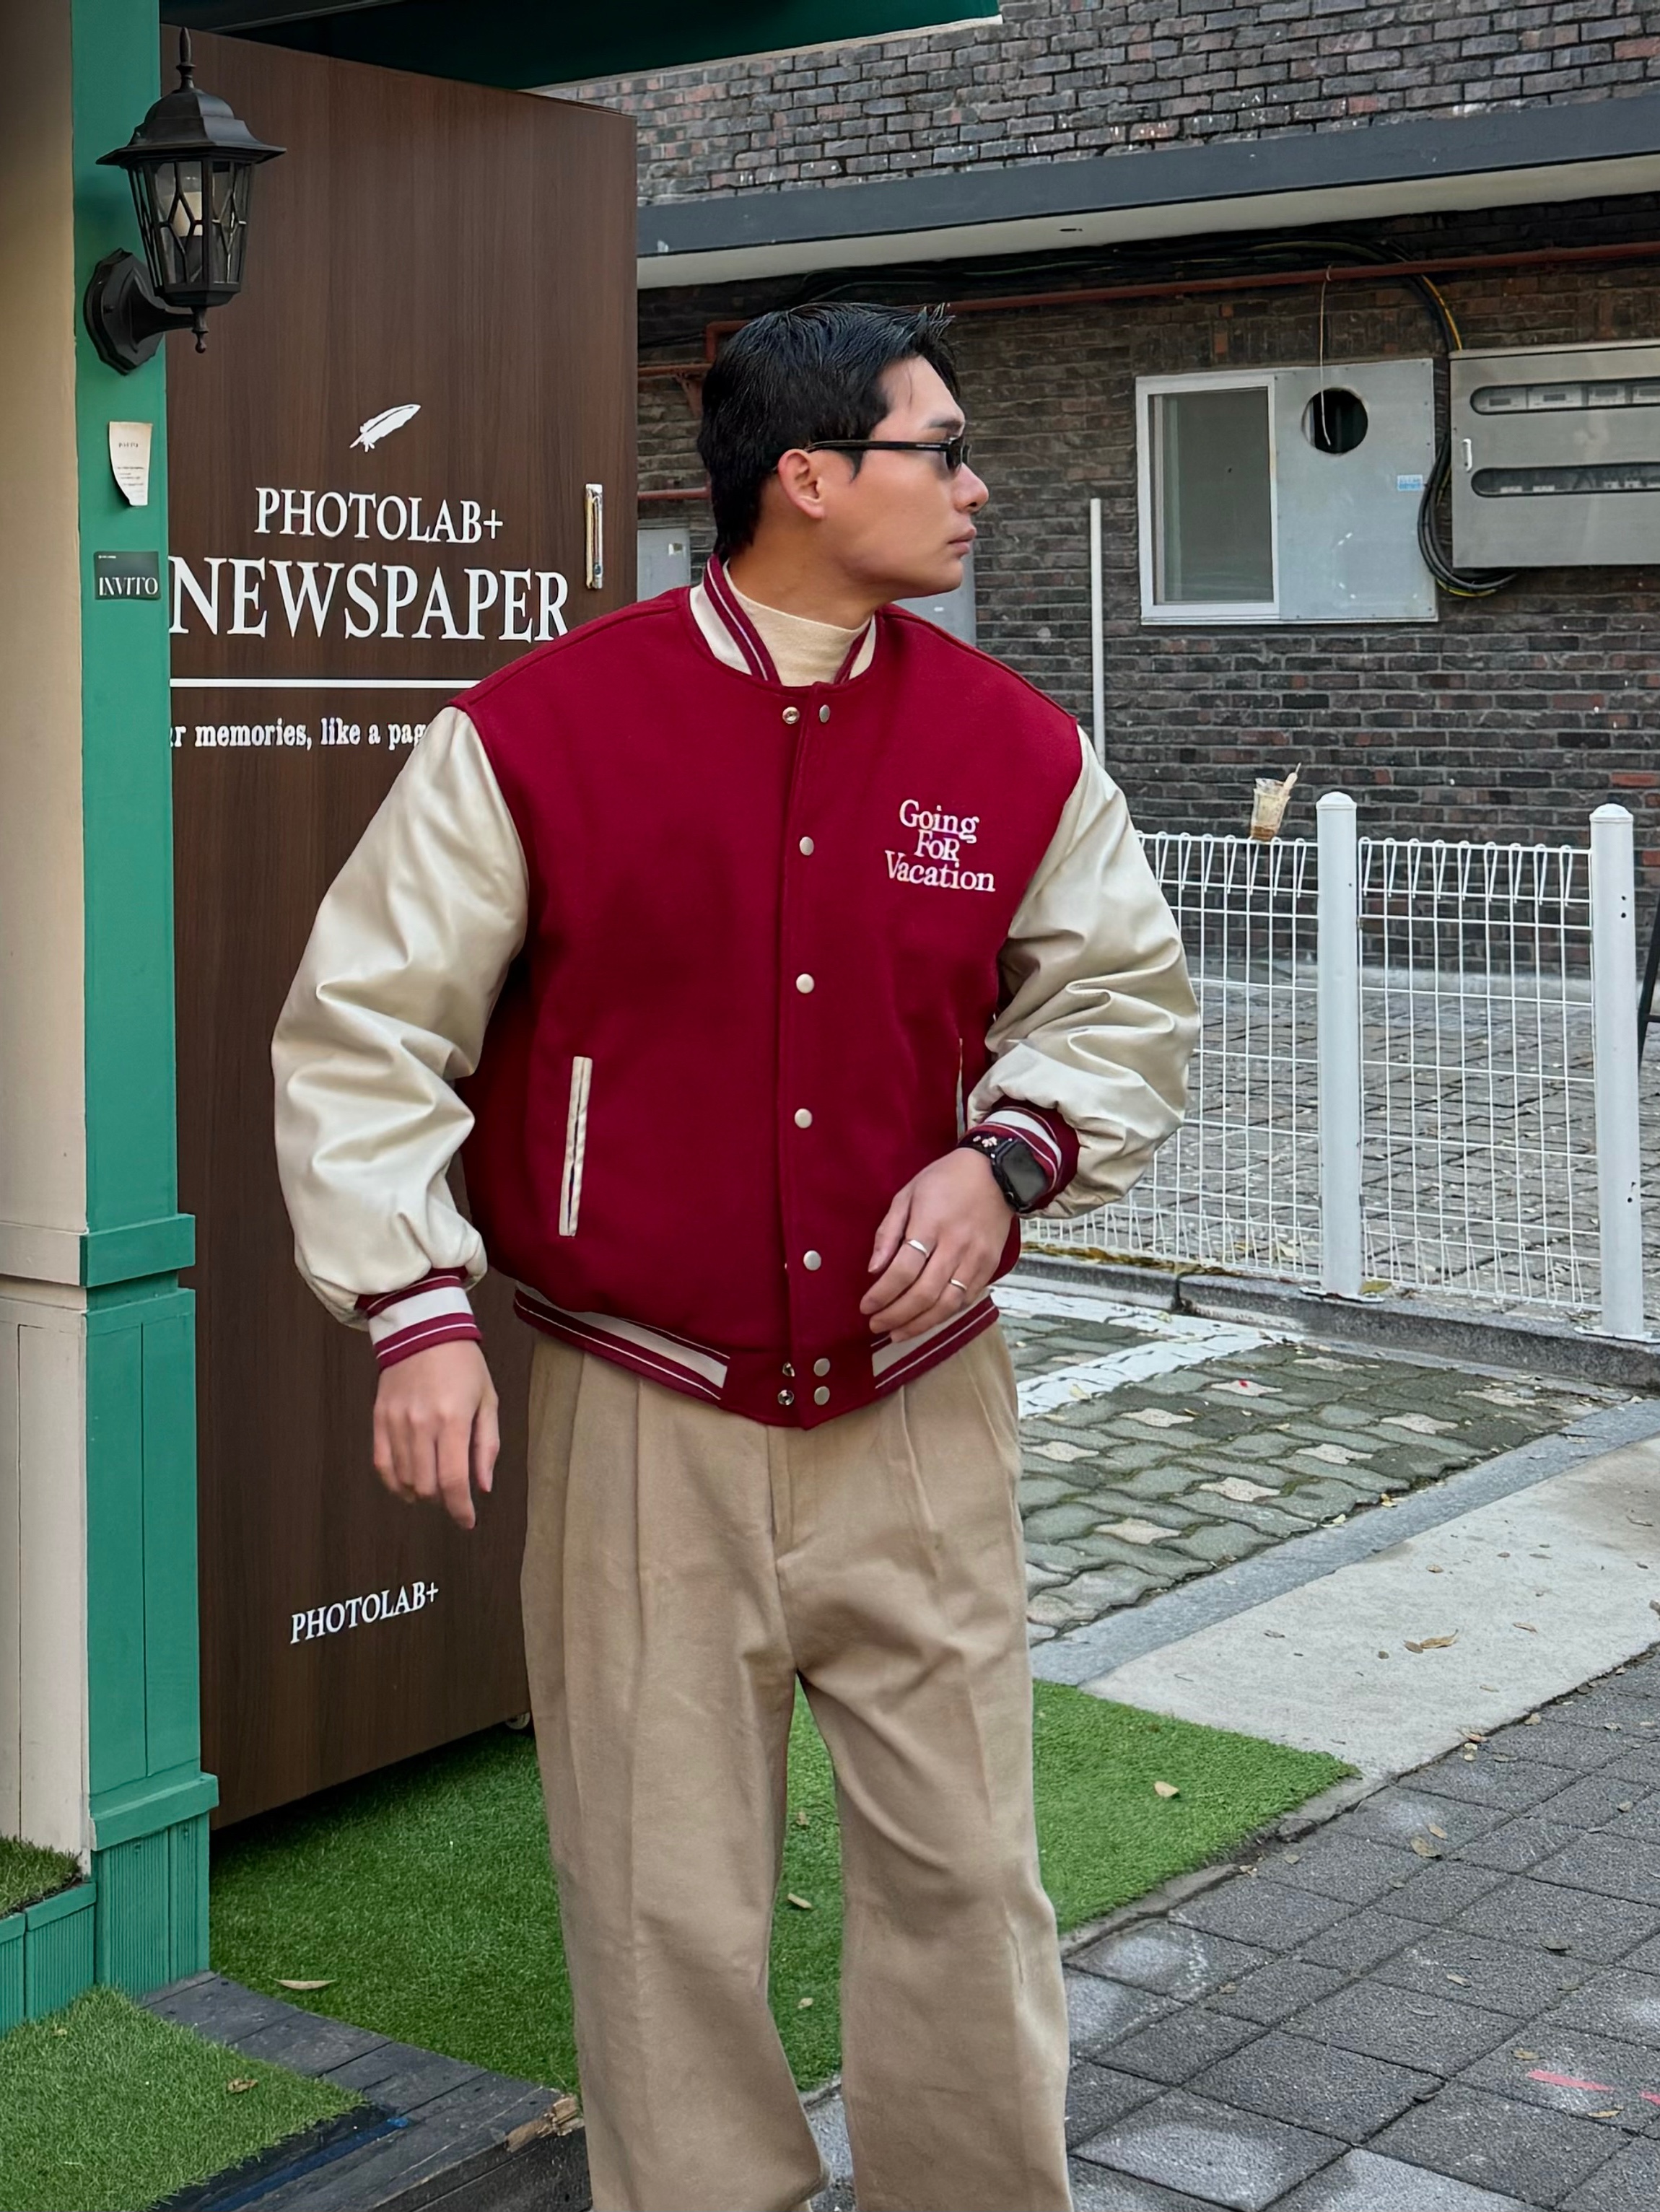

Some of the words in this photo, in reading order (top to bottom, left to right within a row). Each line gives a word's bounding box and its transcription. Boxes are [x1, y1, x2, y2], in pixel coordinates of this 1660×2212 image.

[254, 487, 504, 543] PHOTOLAB+
[99, 577, 159, 596] INVITO
[168, 555, 569, 643] NEWSPAPER
[170, 725, 187, 748] r
[195, 717, 313, 751] memories,
[320, 717, 361, 746] like
[368, 724, 381, 745] a
[388, 724, 427, 751] pag
[899, 799, 980, 844] Going
[884, 849, 996, 893] Vacation
[290, 1581, 439, 1644] PHOTOLAB+
